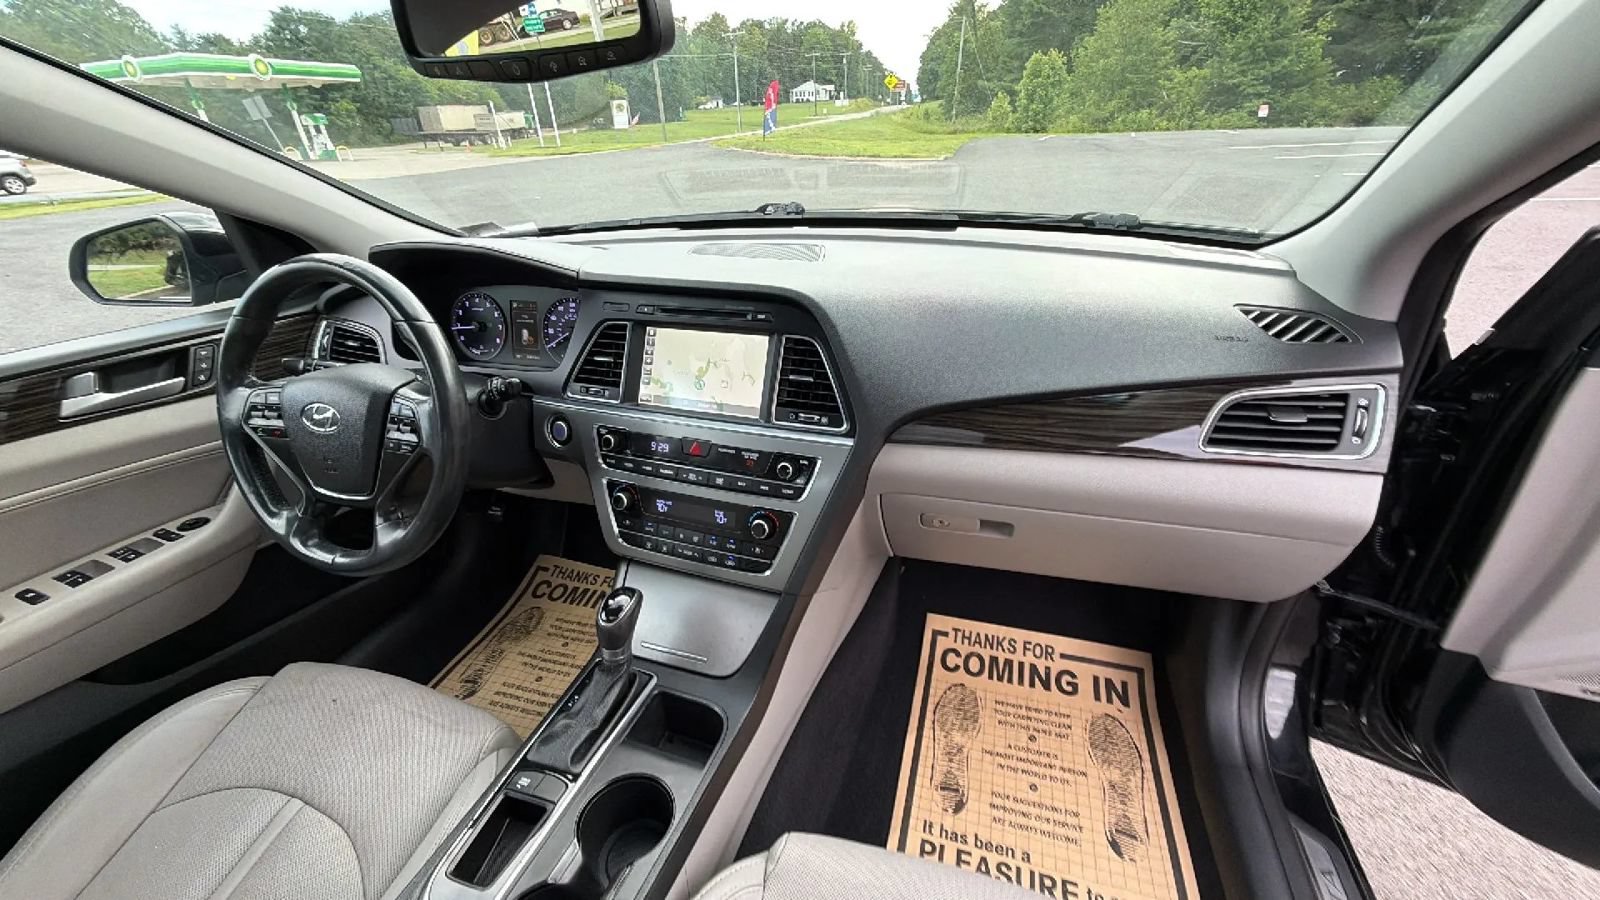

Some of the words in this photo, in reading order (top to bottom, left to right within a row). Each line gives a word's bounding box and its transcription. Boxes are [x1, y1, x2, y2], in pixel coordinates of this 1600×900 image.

[550, 564, 600, 586] THANKS
[952, 628, 1017, 654] THANKS
[1022, 640, 1056, 662] FOR
[940, 648, 1079, 696] COMING
[1092, 674, 1131, 709] IN
[1051, 721, 1072, 730] CLEAN
[990, 802, 1032, 820] IMPROVING
[1034, 815, 1050, 824] OUR
[992, 816, 1005, 826] ARE
[1065, 808, 1080, 818] FOR
[923, 819, 934, 836] It
[939, 823, 969, 845] has
[974, 833, 1016, 859] been
[1021, 851, 1032, 865] a
